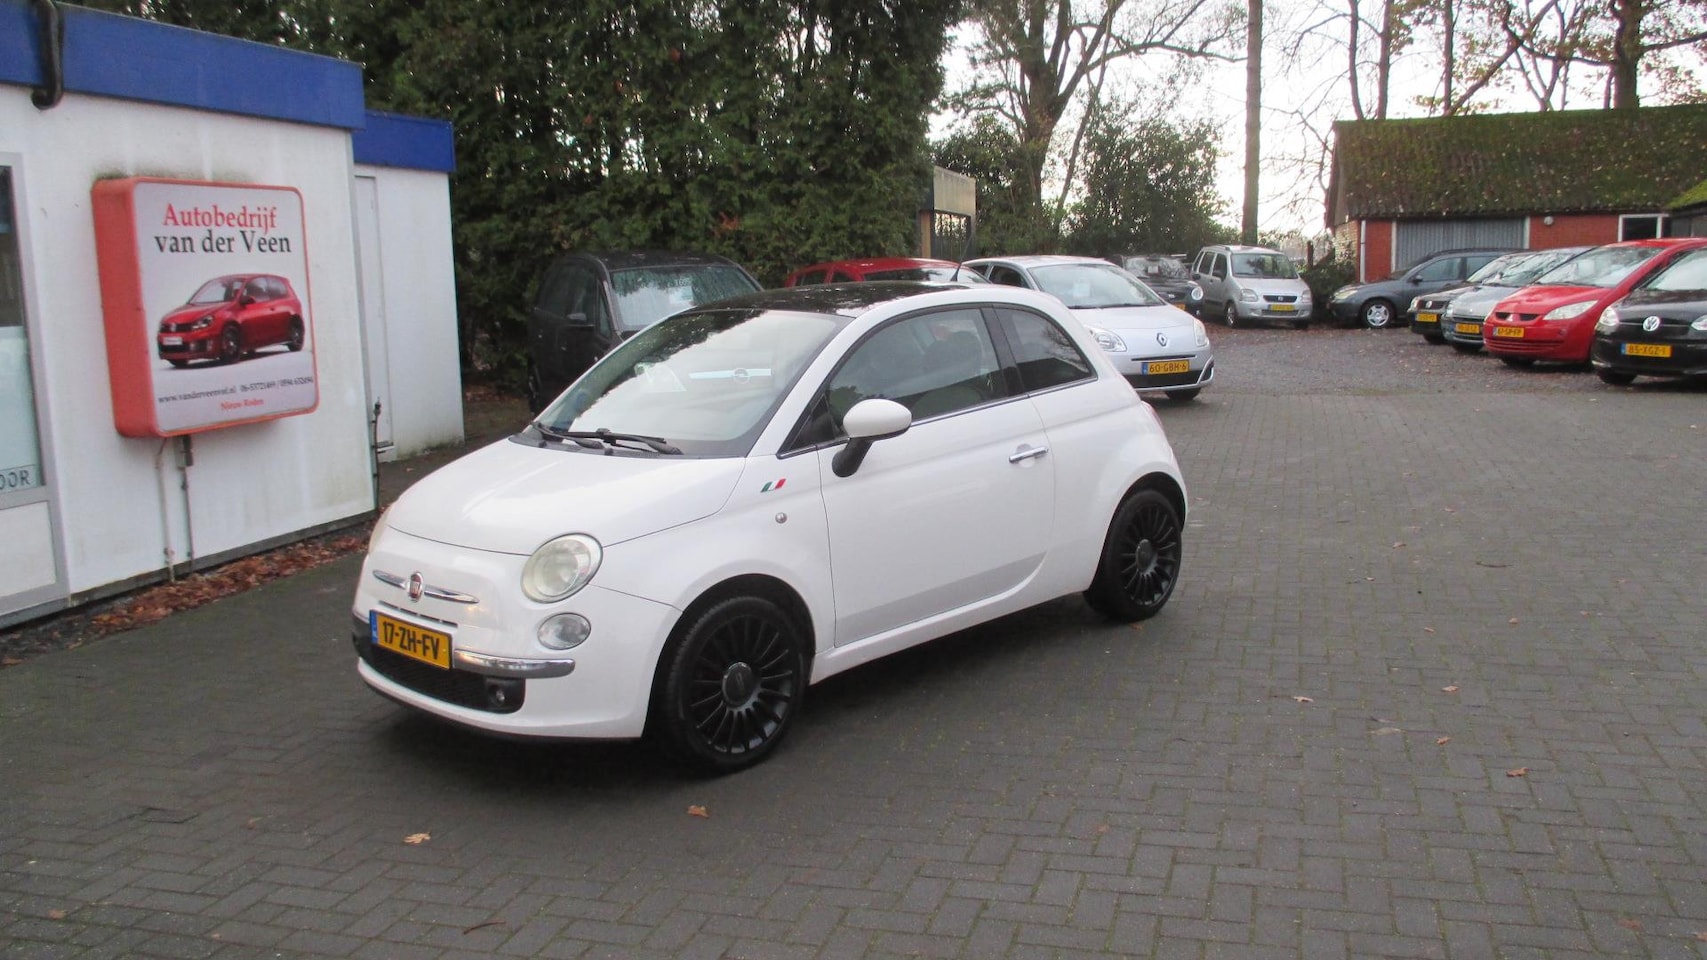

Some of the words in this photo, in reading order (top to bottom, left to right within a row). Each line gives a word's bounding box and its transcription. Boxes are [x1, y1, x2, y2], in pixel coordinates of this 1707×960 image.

[163, 203, 277, 235] Autobedrijf
[154, 236, 195, 253] van
[202, 229, 235, 253] der
[240, 230, 291, 253] Veen
[1150, 362, 1187, 373] 60-GBH-6
[383, 621, 440, 660] 17-ZH-FV
